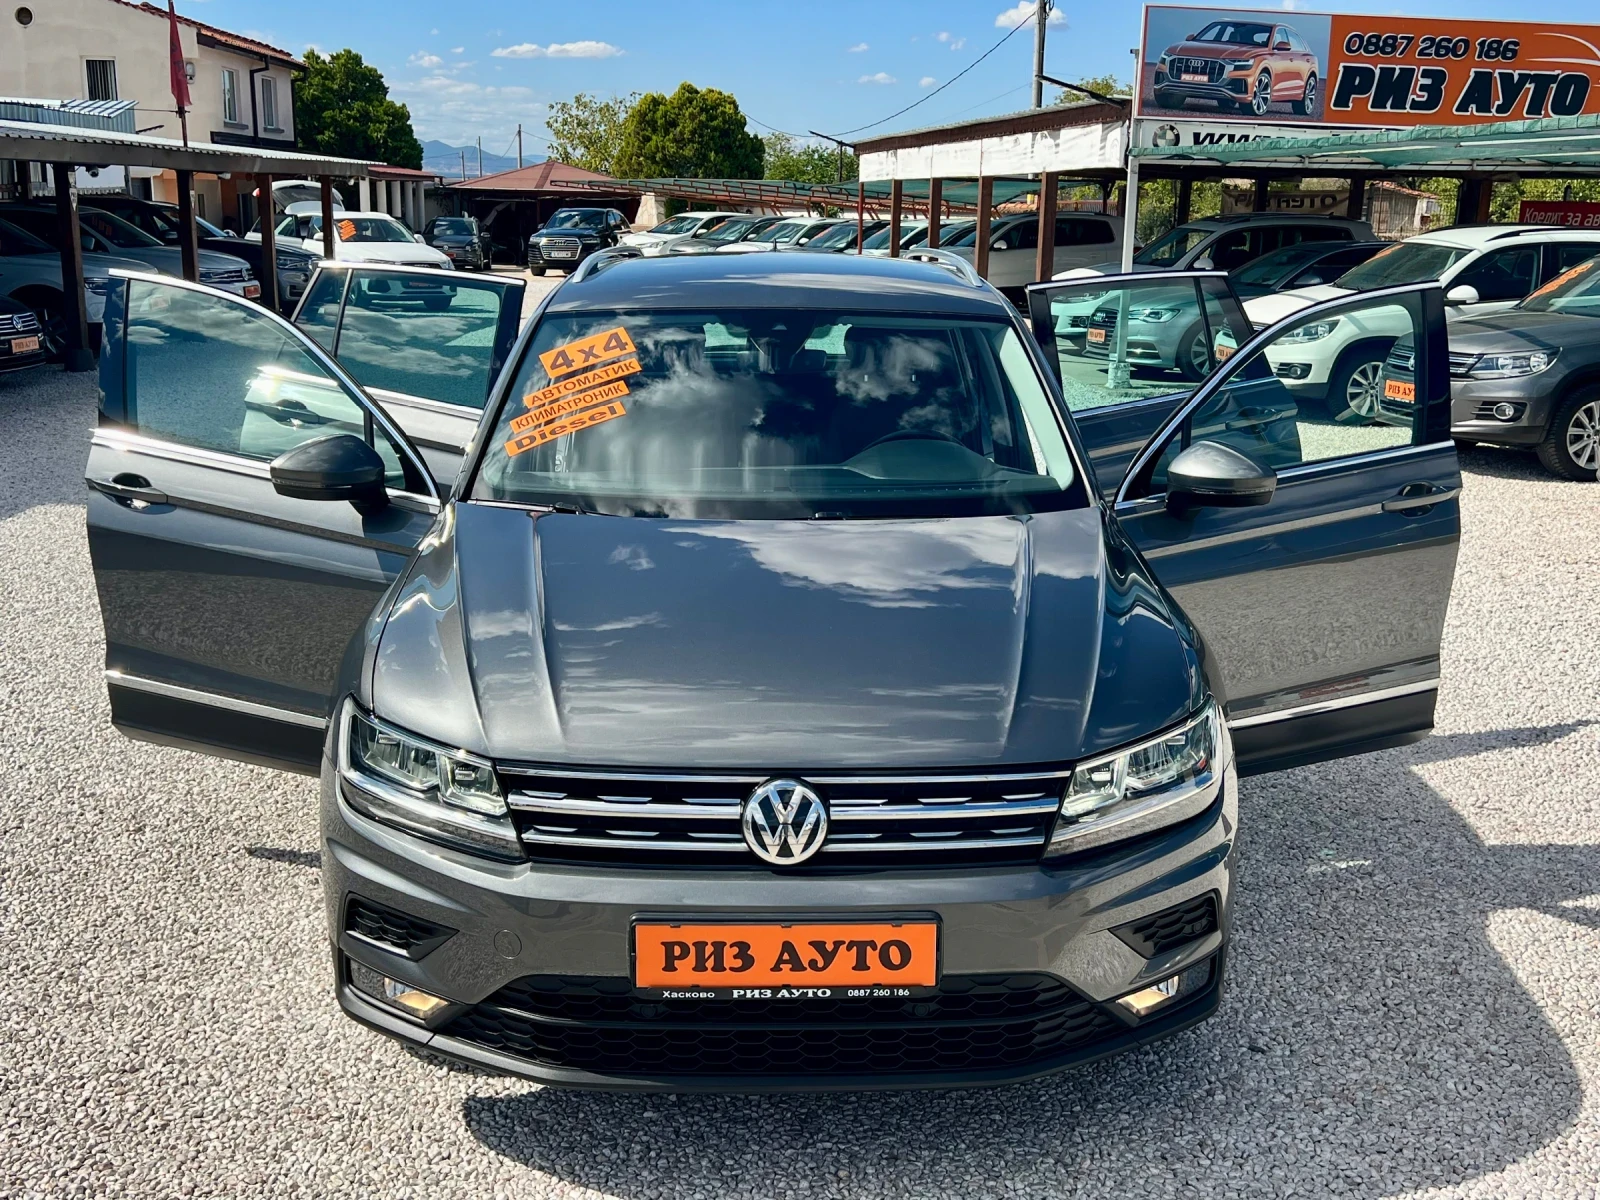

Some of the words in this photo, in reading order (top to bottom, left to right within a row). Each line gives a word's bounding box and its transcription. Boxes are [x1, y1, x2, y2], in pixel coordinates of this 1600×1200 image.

[1344, 32, 1414, 57] 0887
[1417, 36, 1471, 60] 260
[1475, 38, 1520, 62] 186
[1330, 63, 1448, 114] РИЗ
[1453, 68, 1591, 118] АУТО
[1565, 212, 1582, 226] за
[531, 361, 637, 405] АВТОМАТИК
[516, 384, 624, 429] КЛИМАТРОНИК
[514, 405, 618, 451] Diesel
[660, 940, 755, 973] РИЗ
[769, 939, 912, 973] АУТО
[662, 990, 715, 999] Хасково
[732, 989, 772, 998] РИЗ
[776, 988, 832, 998] АУТО
[847, 988, 871, 997] 0887
[872, 988, 890, 997] 260
[893, 988, 910, 997] 186
